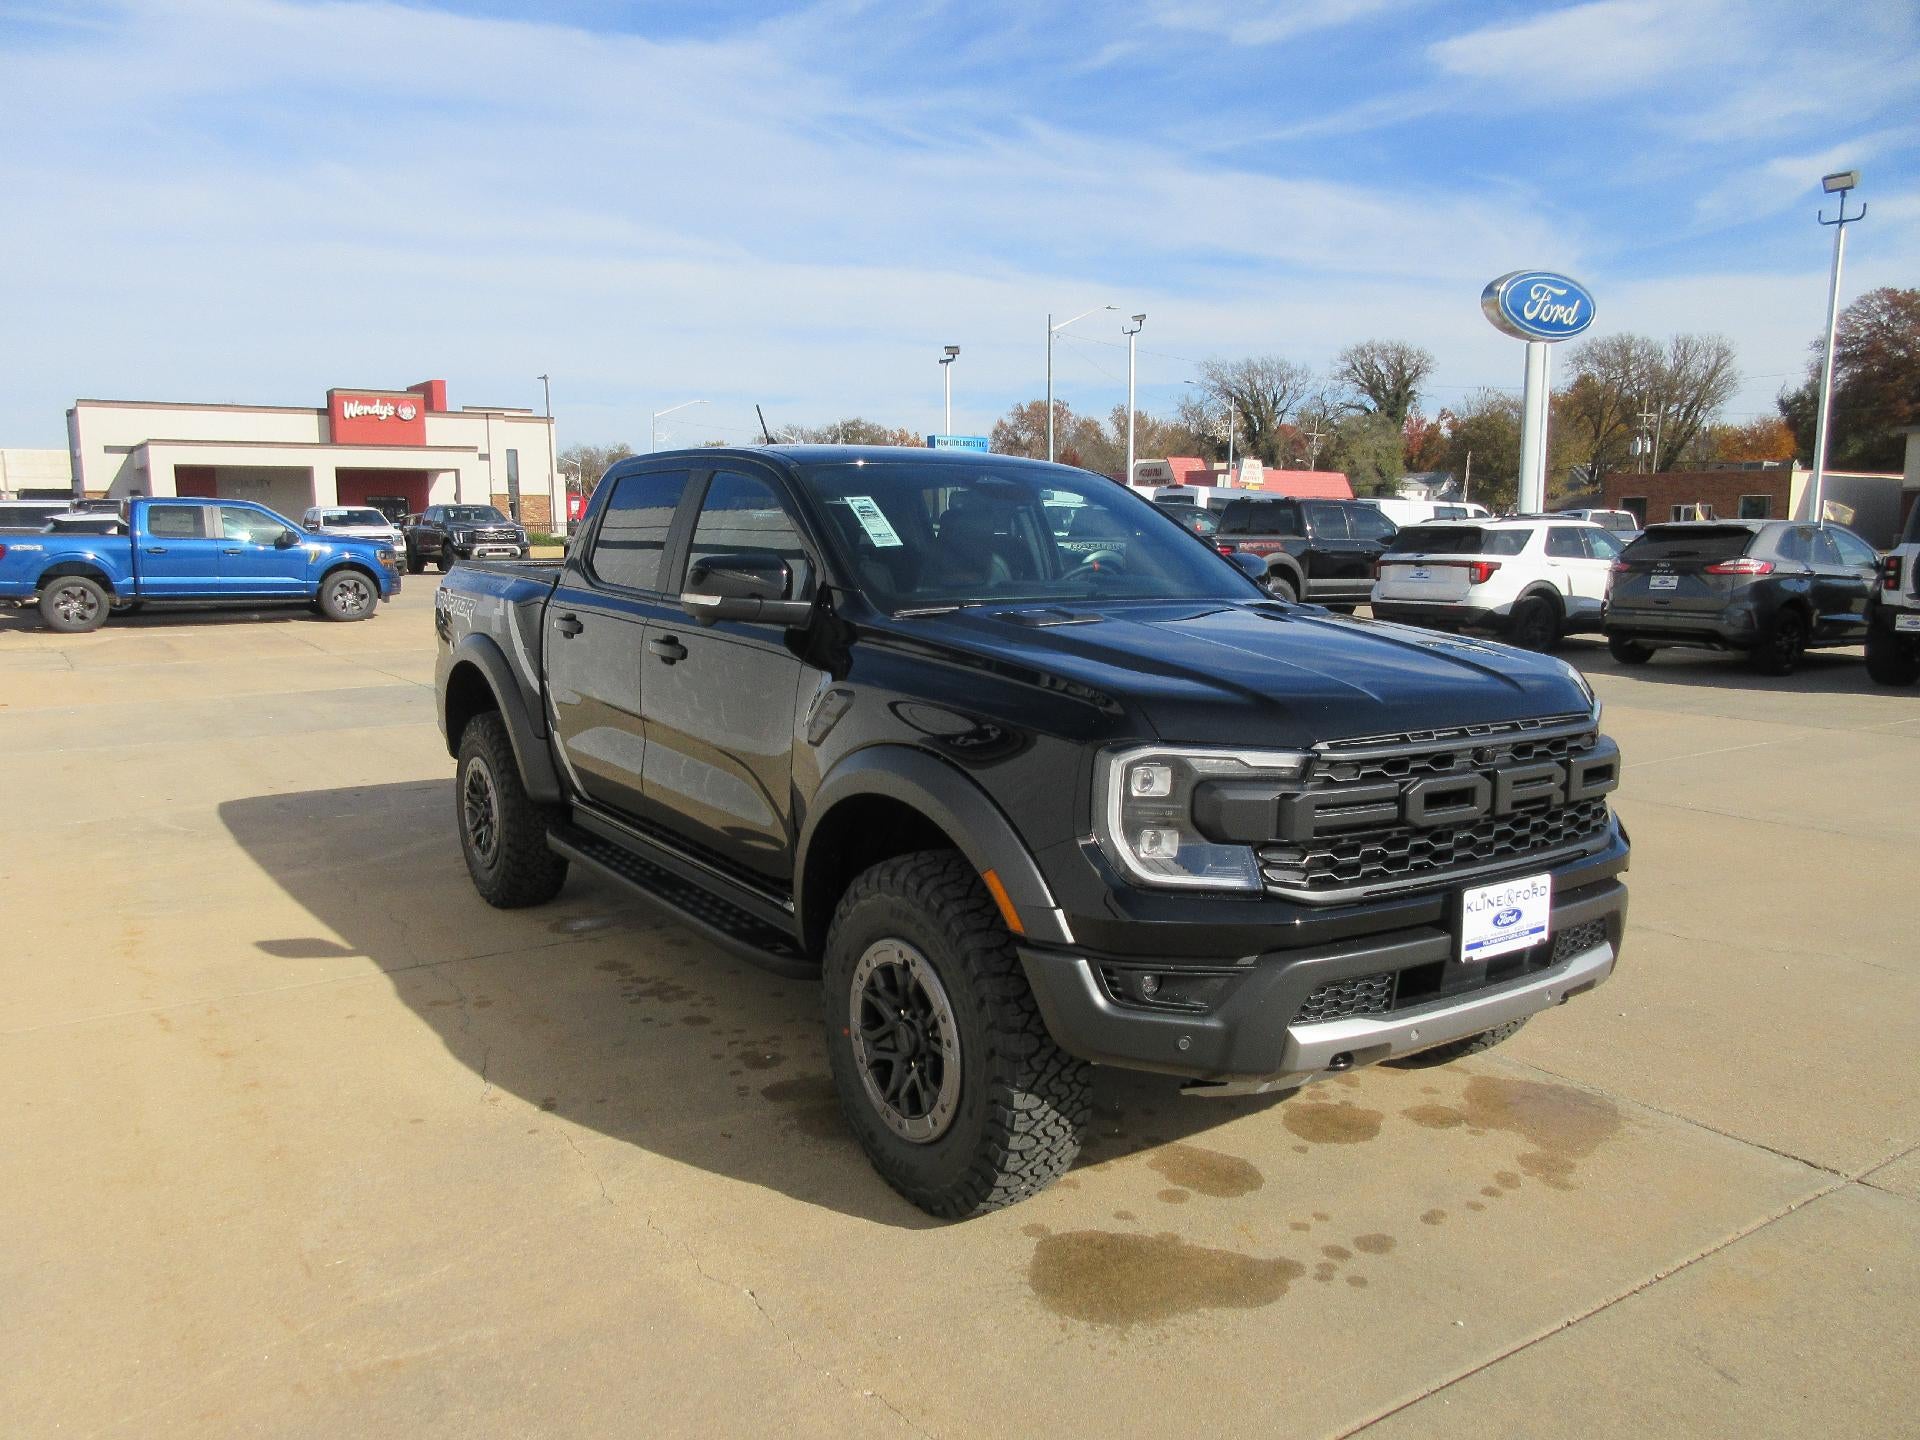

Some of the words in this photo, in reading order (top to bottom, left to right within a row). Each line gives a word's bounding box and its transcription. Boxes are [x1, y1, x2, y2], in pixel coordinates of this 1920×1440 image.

[1523, 283, 1581, 326] Ford
[343, 399, 395, 420] Wendy's
[1239, 542, 1281, 551] RAPTOR
[1281, 742, 1620, 843] FORD
[1466, 895, 1504, 913] KLINE
[1515, 885, 1548, 902] FORD
[1497, 910, 1519, 926] Ford
